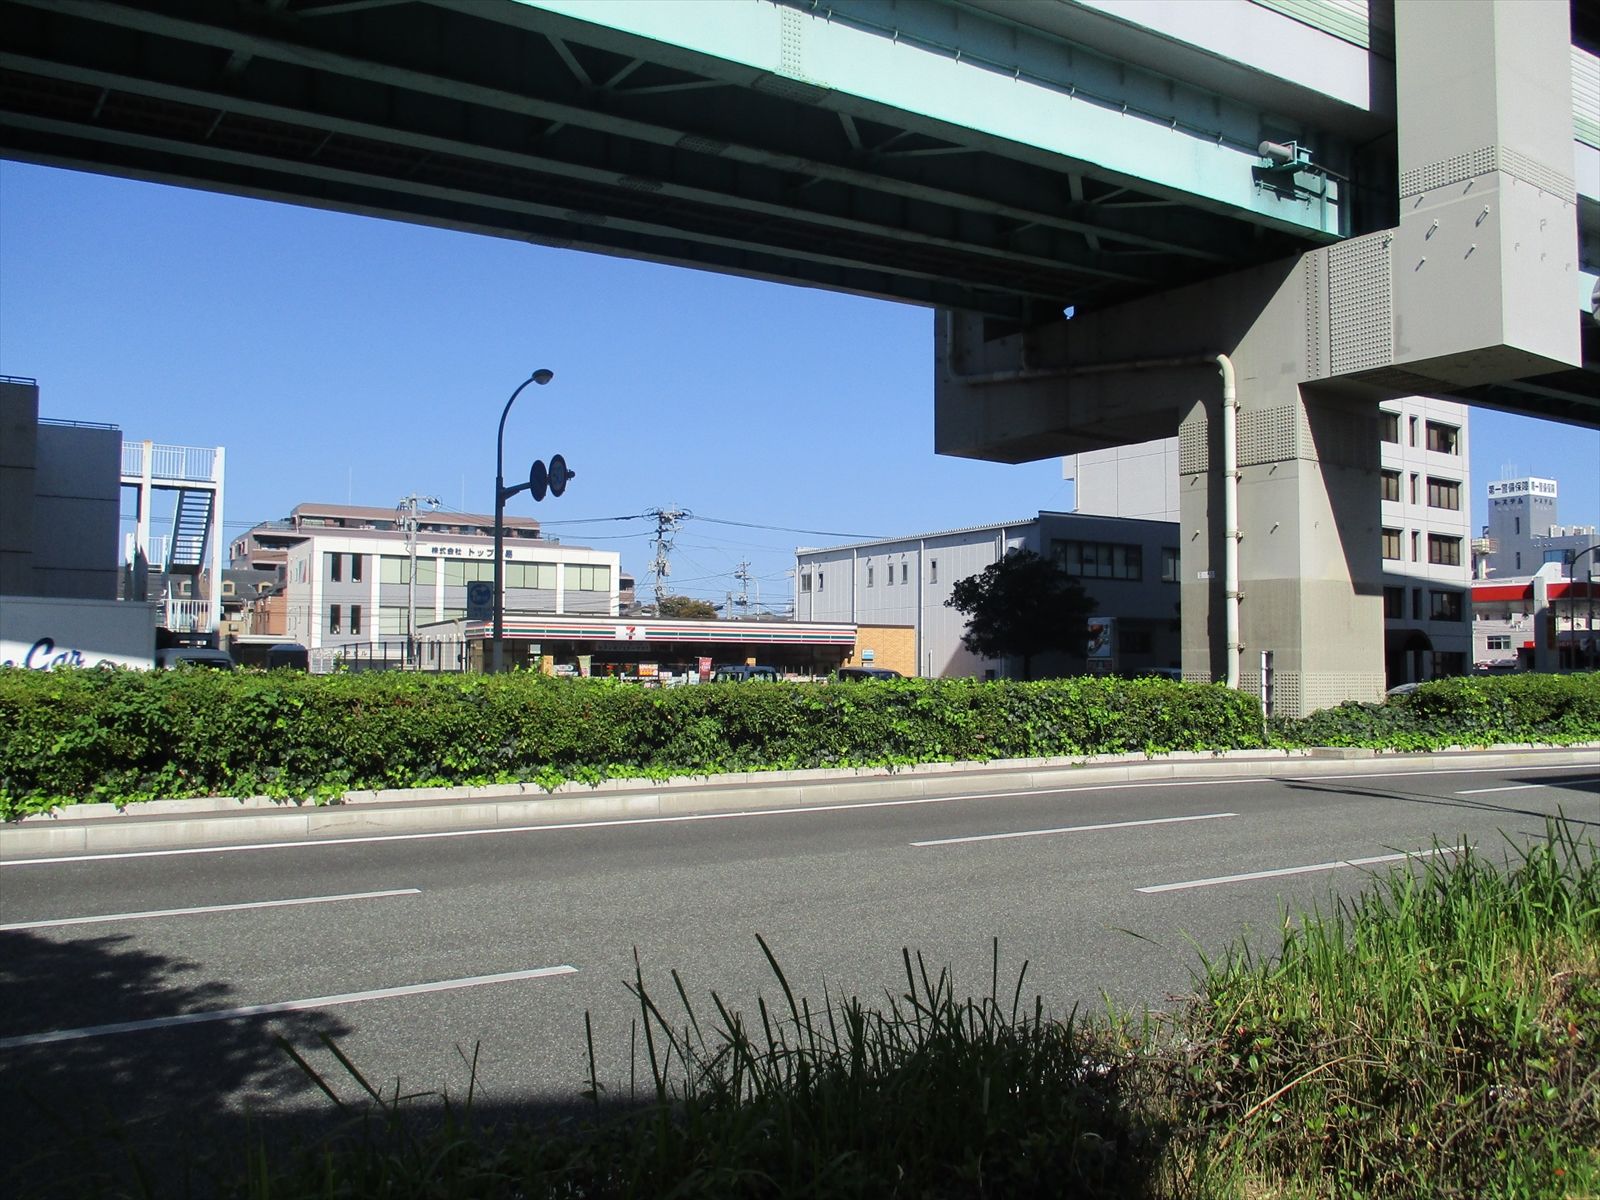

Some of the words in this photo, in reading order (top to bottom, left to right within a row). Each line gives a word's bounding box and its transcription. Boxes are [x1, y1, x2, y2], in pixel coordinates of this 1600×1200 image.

[431, 546, 462, 555] 株式会社
[24, 637, 85, 670] Car
